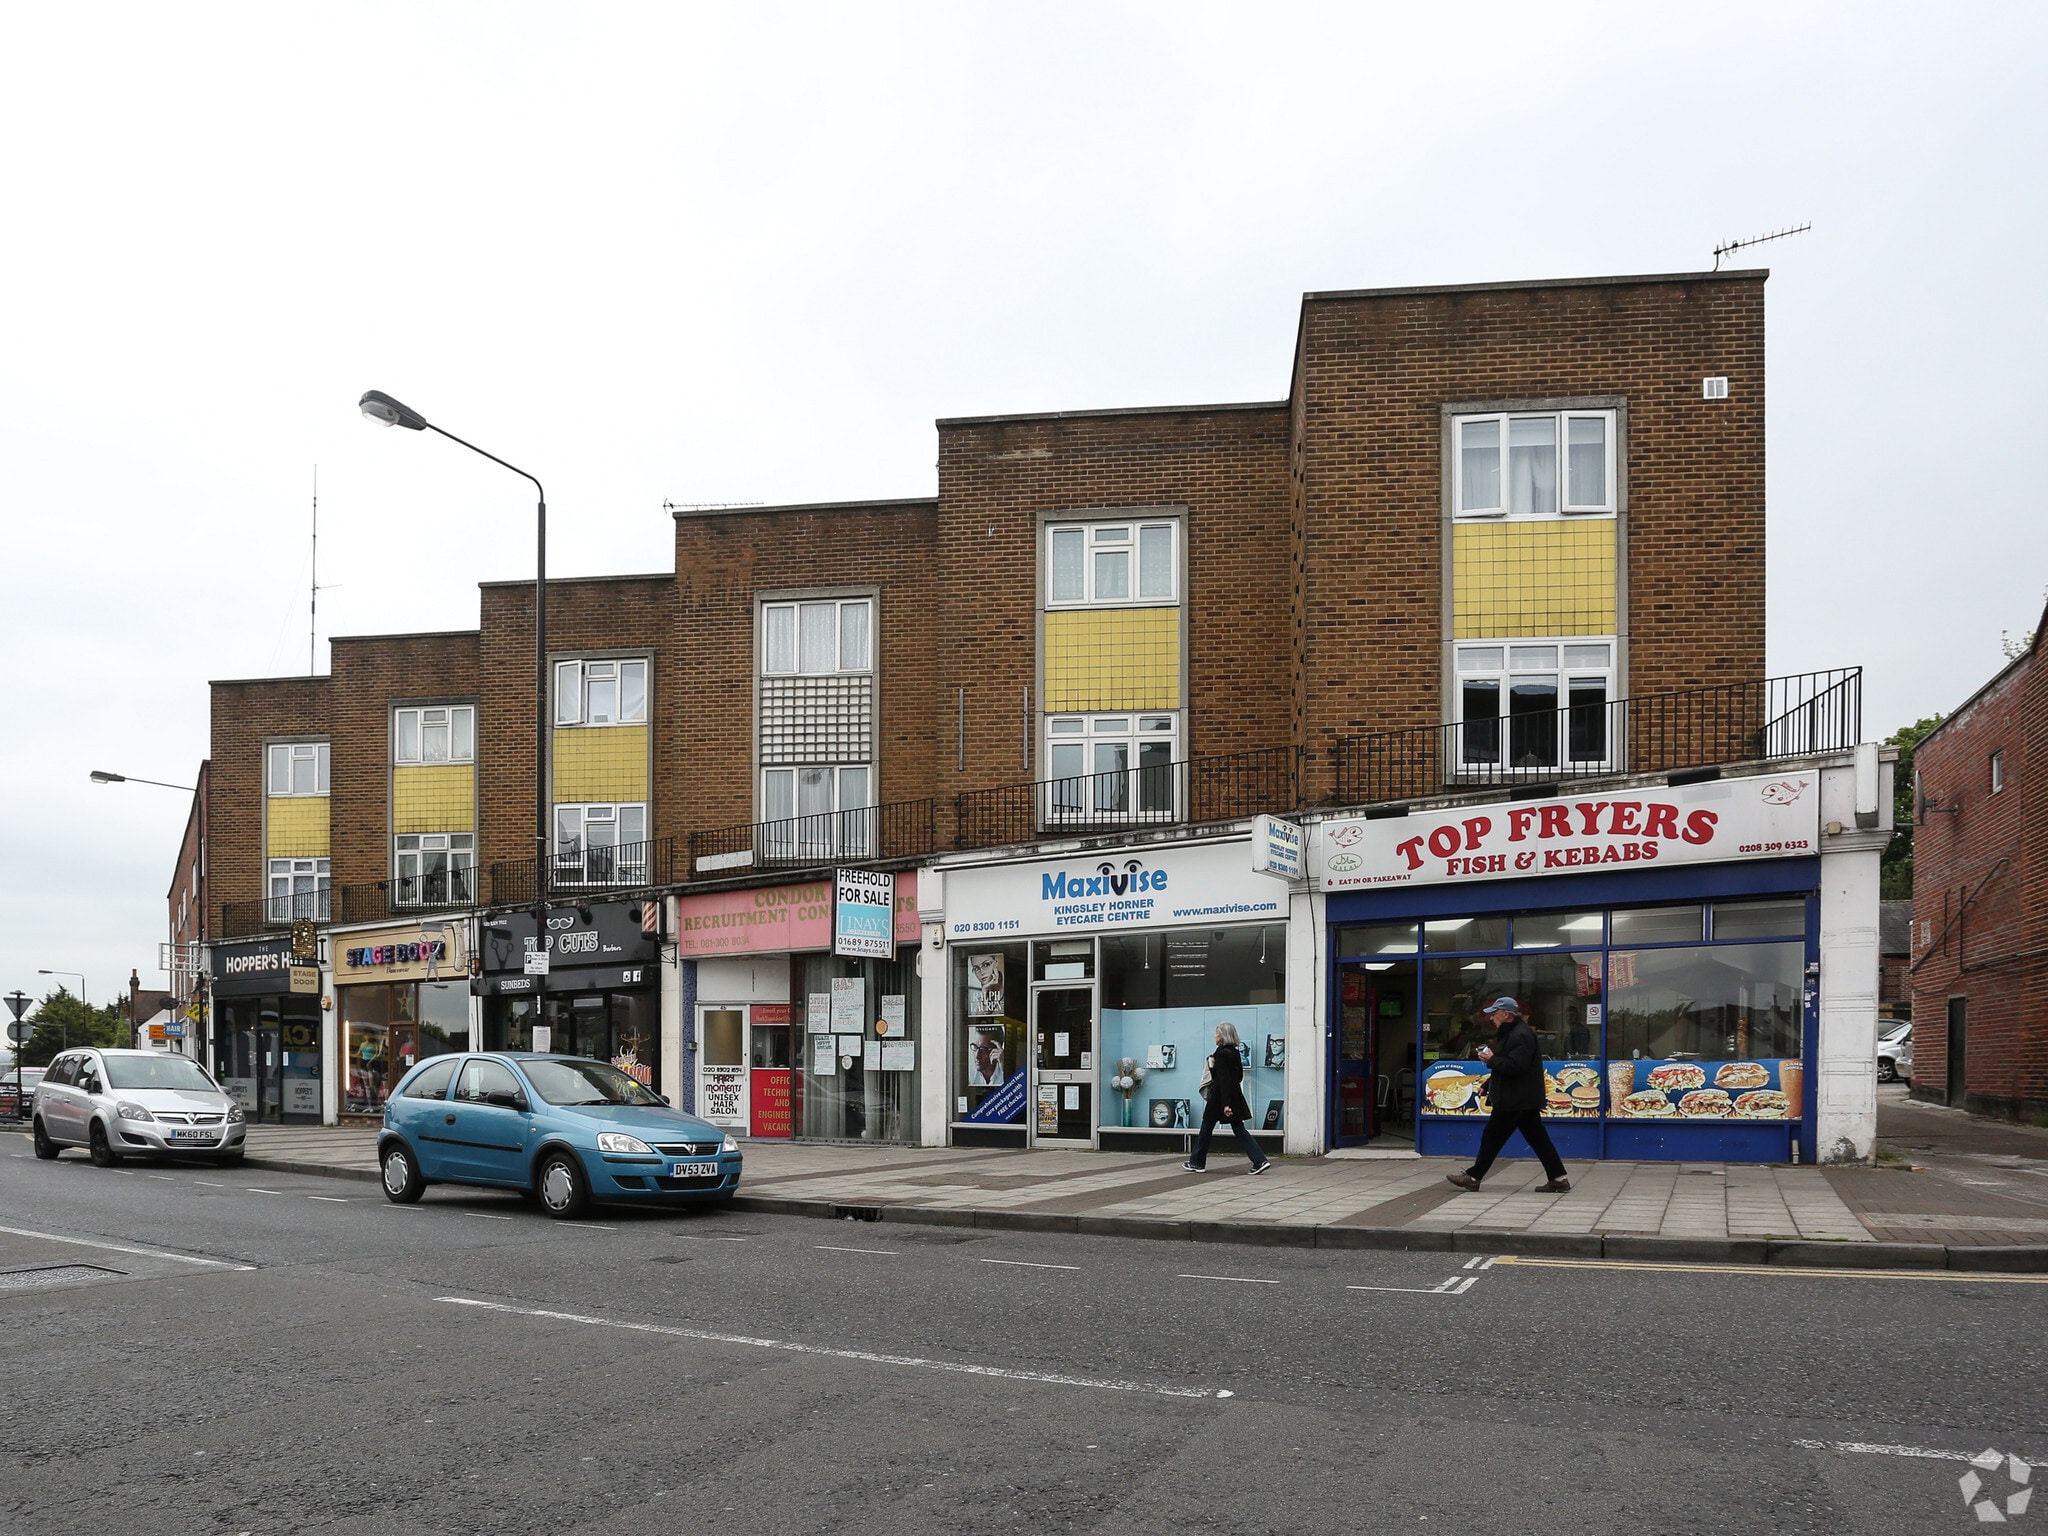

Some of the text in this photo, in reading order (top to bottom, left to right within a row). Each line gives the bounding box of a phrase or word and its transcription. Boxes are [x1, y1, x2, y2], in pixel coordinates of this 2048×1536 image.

[1268, 822, 1299, 846] Maxivise
[1396, 801, 1719, 871] TOP FRYERS
[1739, 840, 1808, 853] 0208 309 6323
[1446, 841, 1659, 876] FISH & KEBABS
[839, 869, 890, 888] FREEHOLD
[1042, 863, 1168, 900] Maxivise
[1327, 878, 1334, 886] 6
[1373, 874, 1412, 882] TAKEAWAY
[754, 884, 827, 908] CONDOR
[839, 887, 890, 906] FOR SALE
[1054, 898, 1154, 915] KINGSLEY HORNER
[1172, 902, 1277, 917] www.maxivise.com
[684, 909, 788, 931] RECRUITMENT
[840, 914, 889, 938] LINAYS
[954, 920, 1020, 933] 020 8300 1151
[1056, 910, 1150, 926] EYECARE CENTRE
[558, 931, 599, 954] CUTS
[684, 940, 699, 949] TEL:
[838, 937, 890, 948] 01689 875511
[346, 940, 446, 967] STAGE DOOR
[226, 953, 279, 974] HOPPER'S
[293, 970, 316, 978] STAGE
[500, 979, 531, 990] SUNBEDS
[402, 998, 406, 1008] 2
[972, 991, 1001, 1002] RALPH
[970, 1001, 1002, 1012] LAUREN
[706, 1084, 742, 1094] MOMENTS
[1000, 1072, 1025, 1094] contact lens
[774, 1099, 790, 1107] AND
[971, 1092, 1001, 1119] Comprehensive
[986, 1107, 995, 1117] care
[994, 1092, 1013, 1110] packages
[1012, 1083, 1023, 1093] with
[997, 1105, 1009, 1116] FREE
[1008, 1092, 1023, 1108] checks!
[675, 1164, 716, 1175] DV53 ZVA
